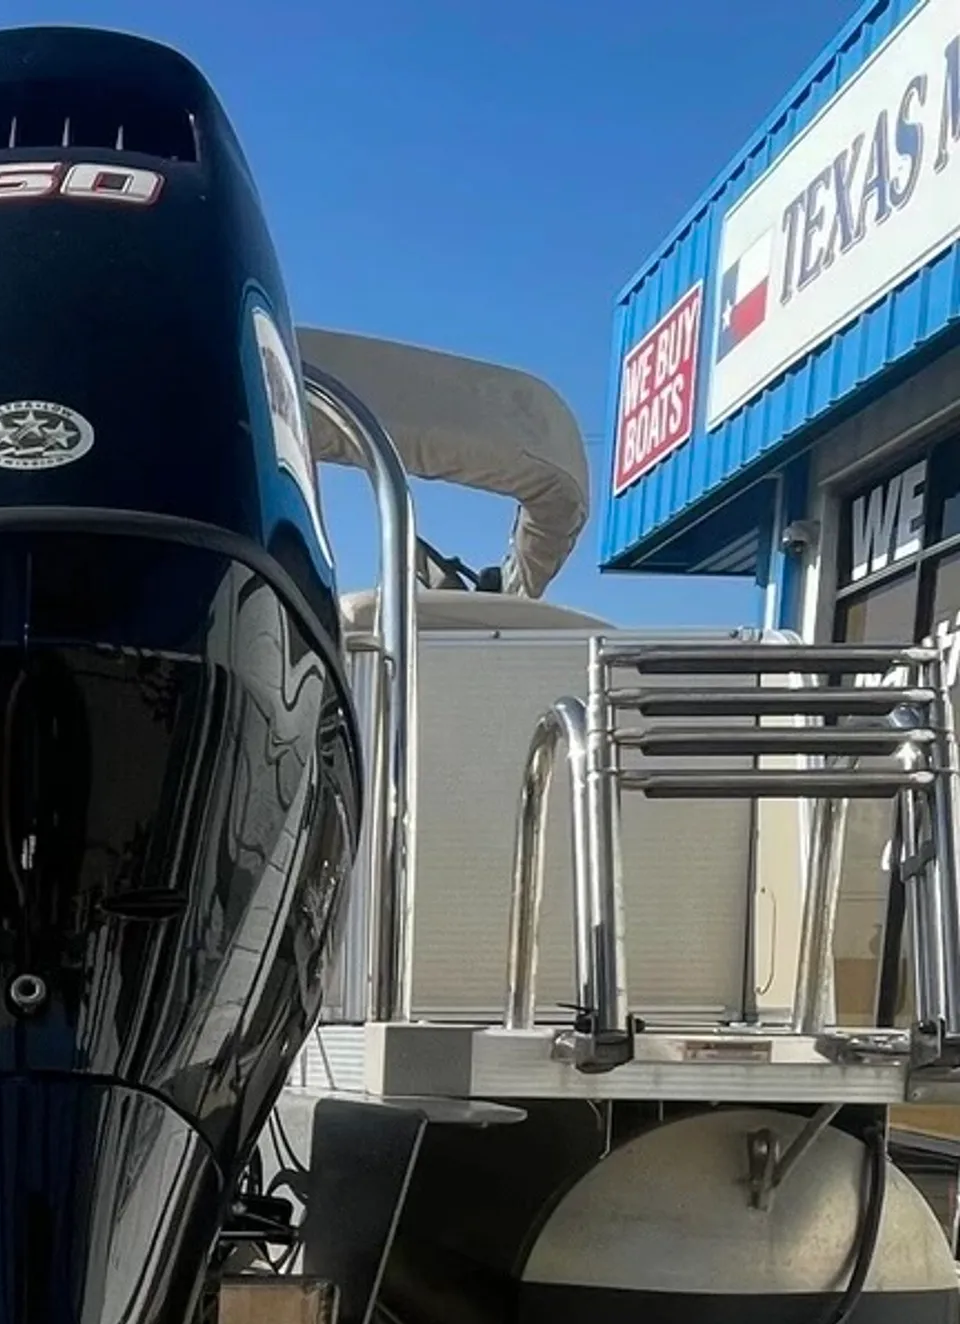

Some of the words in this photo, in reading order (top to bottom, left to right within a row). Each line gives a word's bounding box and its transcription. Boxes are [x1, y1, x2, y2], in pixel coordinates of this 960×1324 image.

[780, 73, 928, 306] TEXAS
[624, 343, 655, 417] WE
[655, 298, 699, 390] BUY
[622, 373, 685, 476] BOATS
[851, 459, 928, 582] WE
